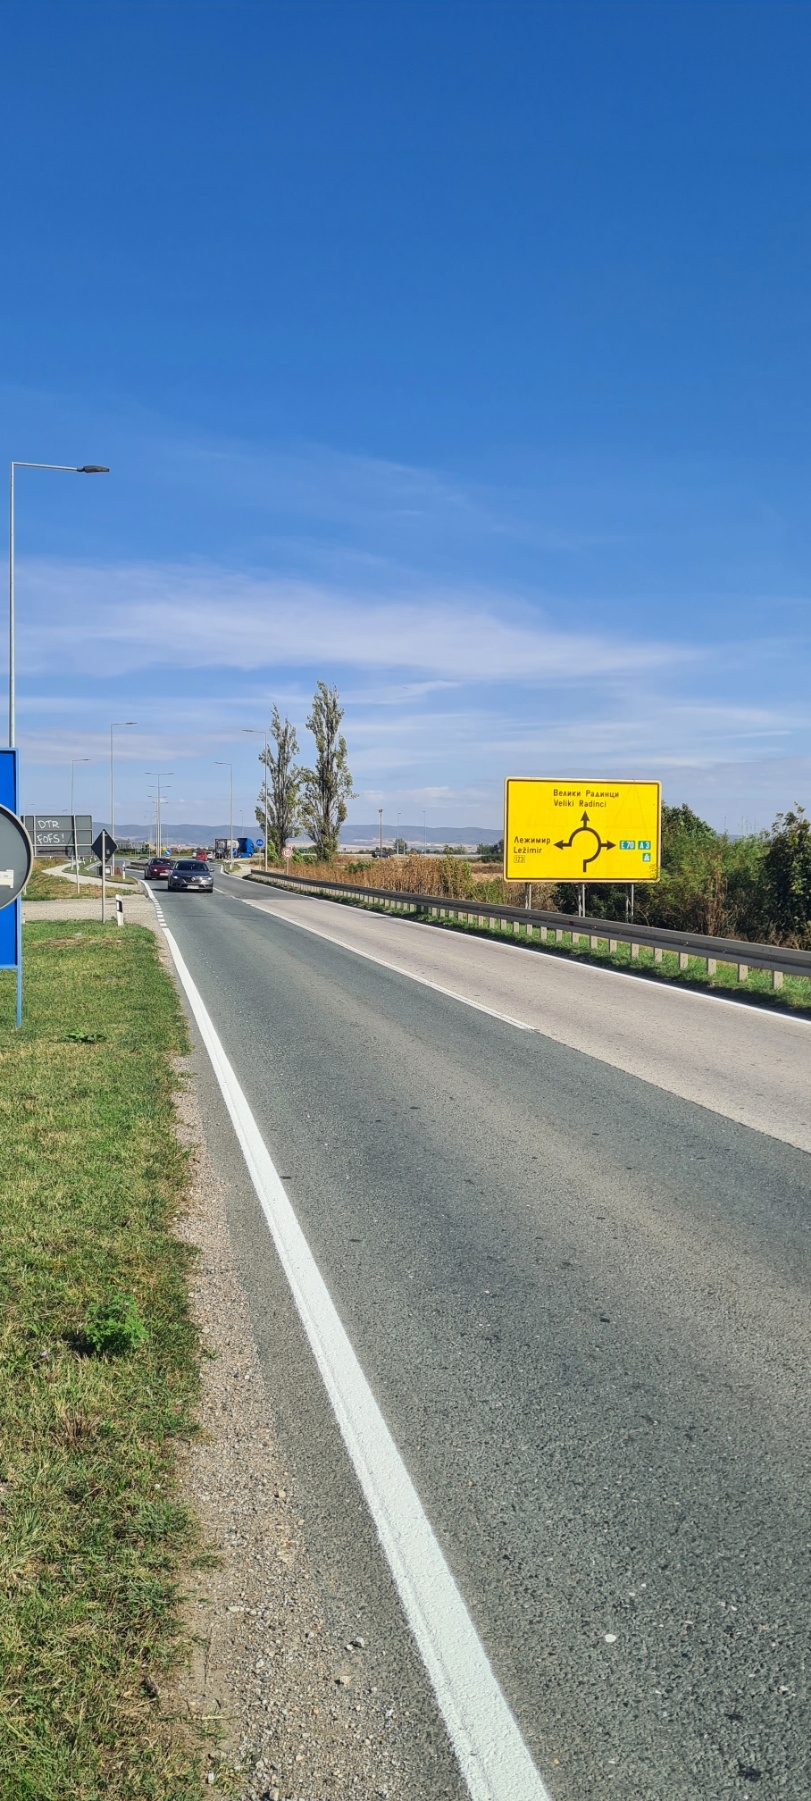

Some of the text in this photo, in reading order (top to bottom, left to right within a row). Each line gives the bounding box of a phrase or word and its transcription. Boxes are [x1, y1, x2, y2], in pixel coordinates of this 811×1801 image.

[553, 789, 620, 798] Велики Радинци
[553, 799, 607, 808] Veliki Radinci
[37, 820, 60, 829] DTR
[514, 836, 551, 845] Лежимир
[513, 846, 542, 854] Ležimir
